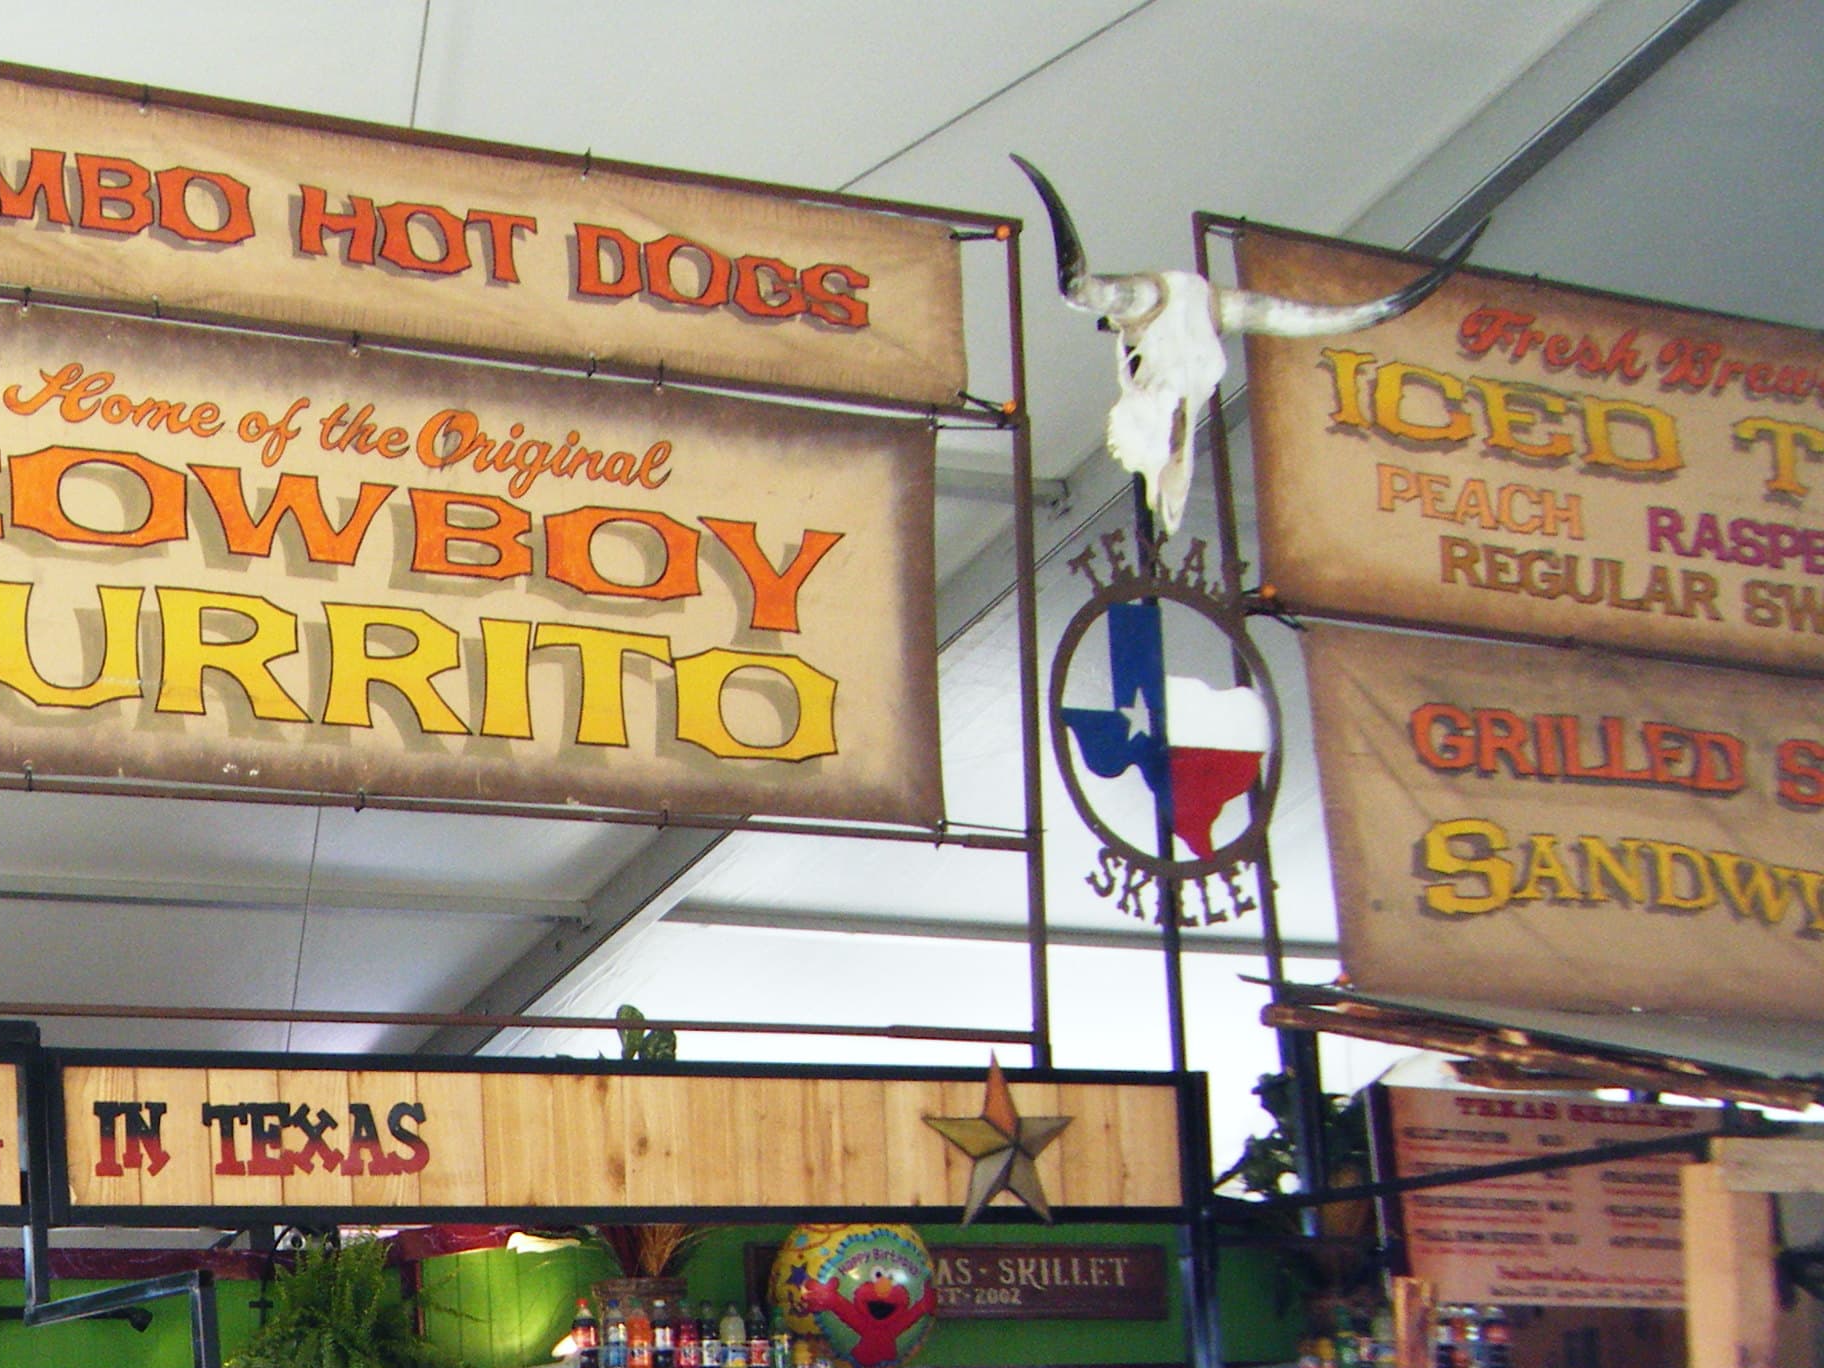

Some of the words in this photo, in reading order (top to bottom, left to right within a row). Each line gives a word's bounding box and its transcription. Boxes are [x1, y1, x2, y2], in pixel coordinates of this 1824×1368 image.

[298, 183, 538, 285] HOT
[573, 222, 871, 332] DOGS
[1460, 308, 1648, 380] Fresh
[2, 362, 225, 438] Home
[237, 396, 311, 467] of
[318, 402, 411, 459] the
[414, 407, 674, 500] Original
[1320, 346, 1686, 474] ICED
[1375, 462, 1585, 541] PEACH
[1439, 535, 1724, 622] REGULAR
[1410, 701, 1746, 794] GRILLED
[92, 1100, 171, 1178] IN
[201, 1100, 431, 1178] TEXAS
[975, 1287, 1023, 1305] 2002
[997, 1256, 1130, 1291] SKILLET
